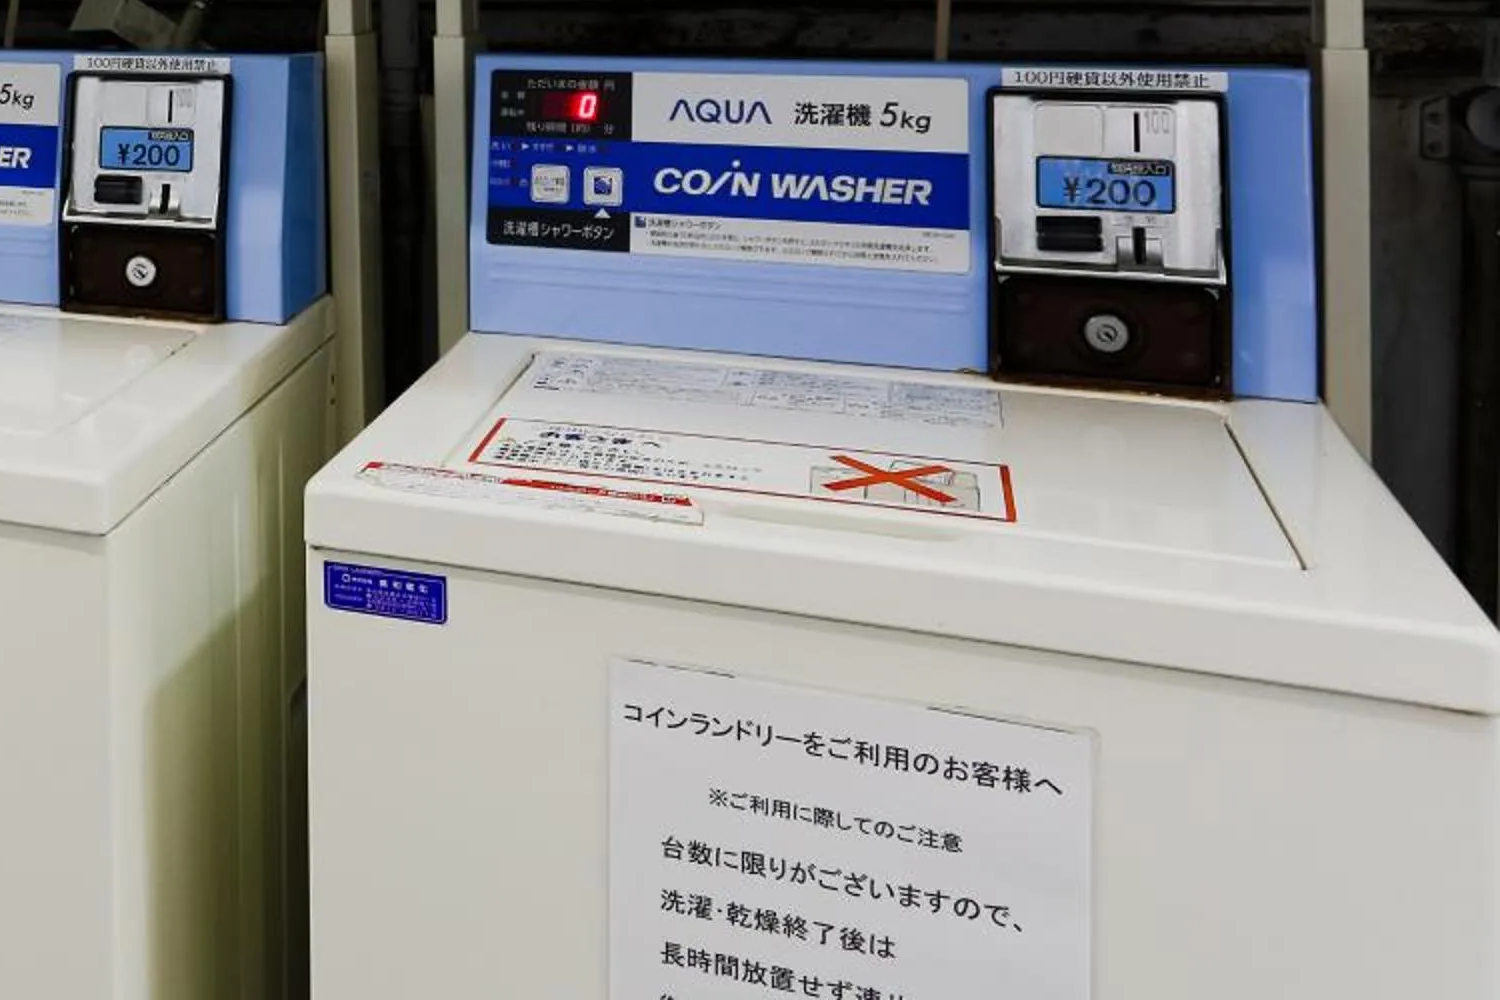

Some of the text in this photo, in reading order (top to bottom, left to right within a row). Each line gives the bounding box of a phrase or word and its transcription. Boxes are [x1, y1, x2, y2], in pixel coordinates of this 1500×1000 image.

[1014, 70, 1210, 90] 100円硬貨以外使用禁止
[579, 94, 598, 119] 0
[669, 98, 772, 126] AQUA
[794, 101, 932, 135] 洗濯機 5kg
[117, 143, 181, 167] ¥200
[653, 160, 934, 206] COIN WASHER
[1063, 177, 1157, 207] ¥200
[623, 703, 1064, 797] コインランドリーをご利用のお客様へ
[708, 787, 964, 854] ※ご利用に際してのご注意
[660, 835, 1026, 934] 台数に限りがございますので、
[660, 888, 898, 960] 洗濯・乾燥終了後は
[660, 940, 904, 1000] 長時間放置せず速
